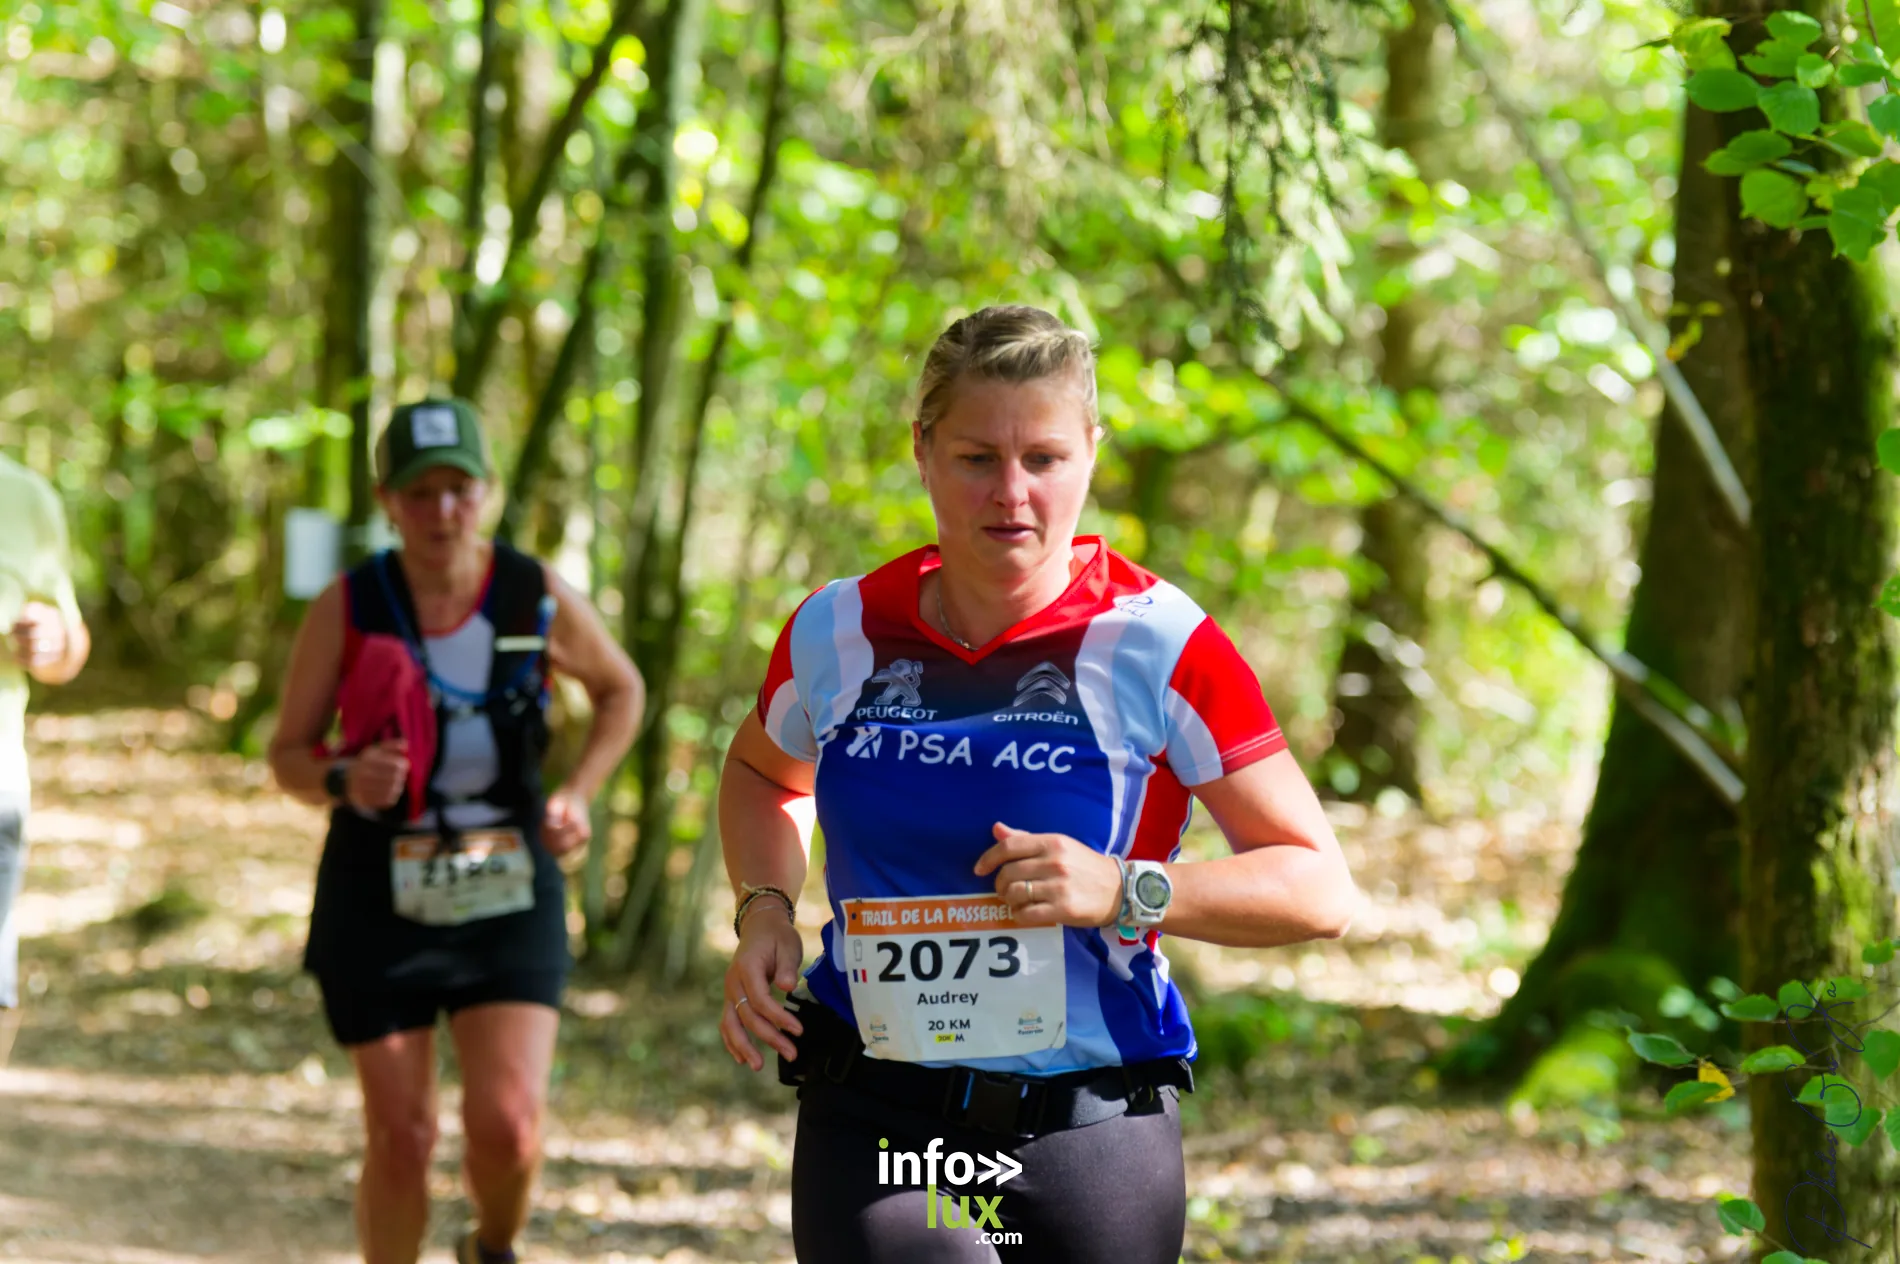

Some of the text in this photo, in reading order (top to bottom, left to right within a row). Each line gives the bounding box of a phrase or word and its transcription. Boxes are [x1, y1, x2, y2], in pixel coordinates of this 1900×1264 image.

[856, 706, 938, 720] PEUGEOT
[898, 730, 1076, 774] PSA ACC
[861, 904, 1014, 927] TRAIL DE LA PASSEREL
[876, 936, 1021, 983] 2073
[917, 992, 979, 1006] Audrey
[928, 1019, 971, 1031] 20 KM
